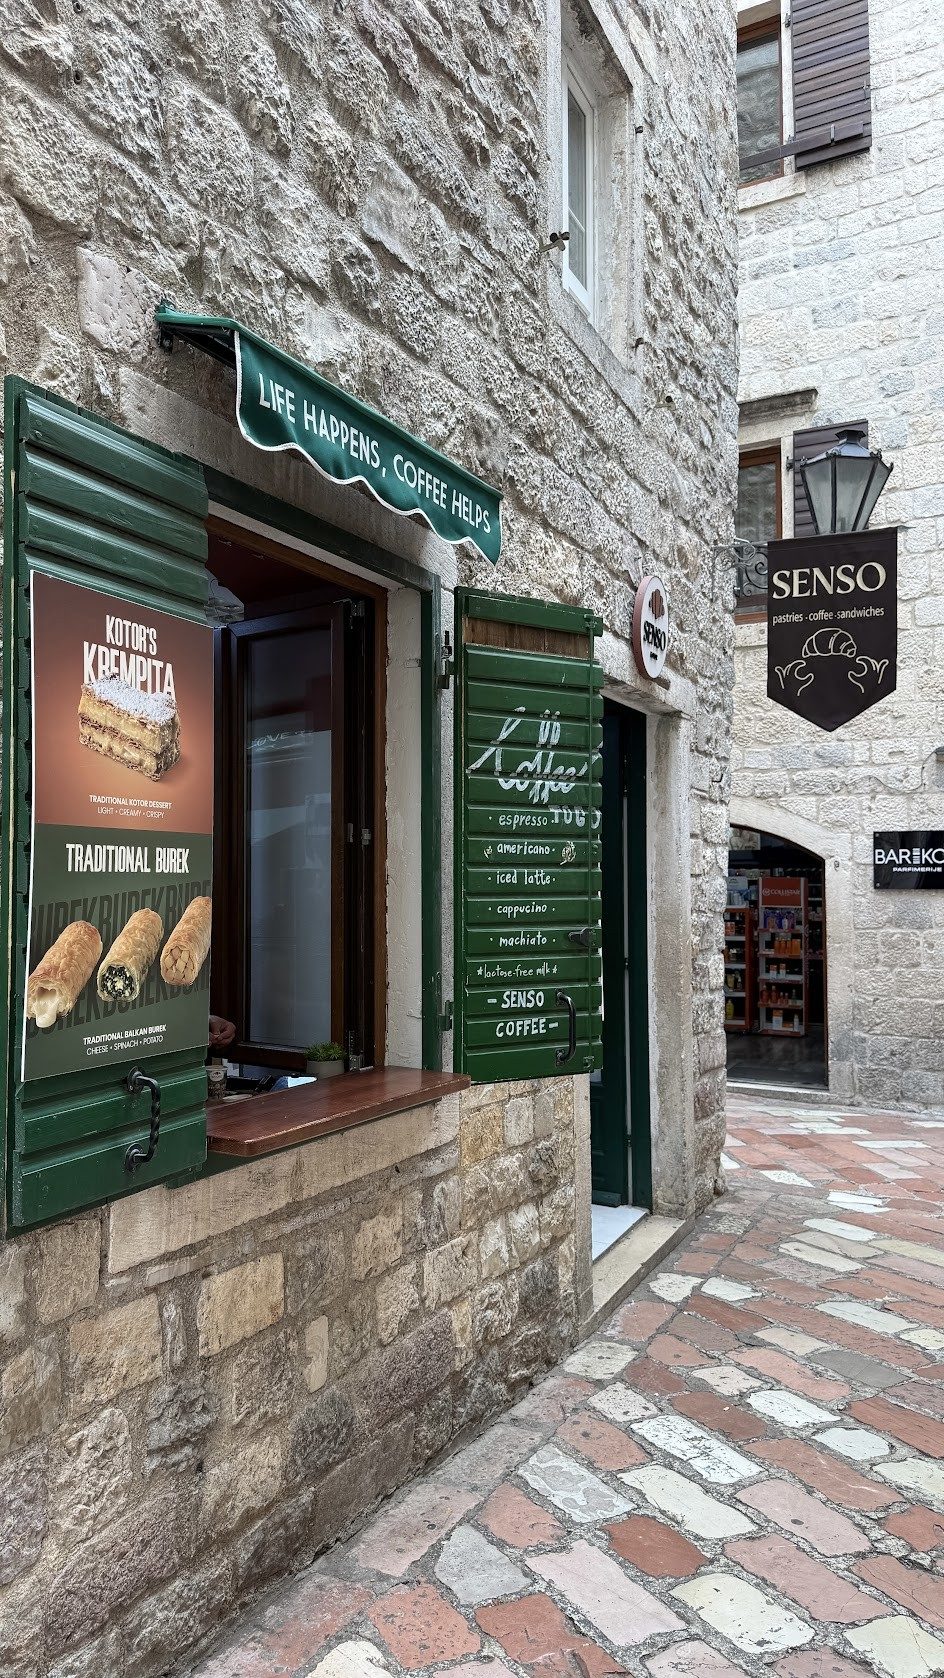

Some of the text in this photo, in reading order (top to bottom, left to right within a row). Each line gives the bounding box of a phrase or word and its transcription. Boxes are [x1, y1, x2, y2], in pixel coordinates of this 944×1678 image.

[258, 373, 491, 534] LIFE HAPPENS, COFFEE HELPS
[772, 561, 887, 600] SENSO
[772, 606, 885, 626] pastries coffee sandwiches
[105, 614, 157, 656] KOTOR'S
[643, 620, 667, 652] SENSO
[88, 794, 173, 810] TRADITIONAL KOTOR DESSERT
[97, 806, 165, 819] LIGHT CREAMY CRISPY
[498, 814, 548, 830] espresso
[496, 841, 551, 855] americano
[65, 843, 190, 874] TRADITIONAL BUREK
[496, 869, 551, 885] iced latte
[496, 901, 548, 918] cappucino
[499, 930, 548, 947] machiato
[500, 990, 545, 1009] SENSO
[82, 1023, 167, 1046] TRADITIONAL BALKAN BUREK
[495, 1017, 547, 1038] COFFEE
[86, 1034, 164, 1056] CHEESE SPINACH POTATO
